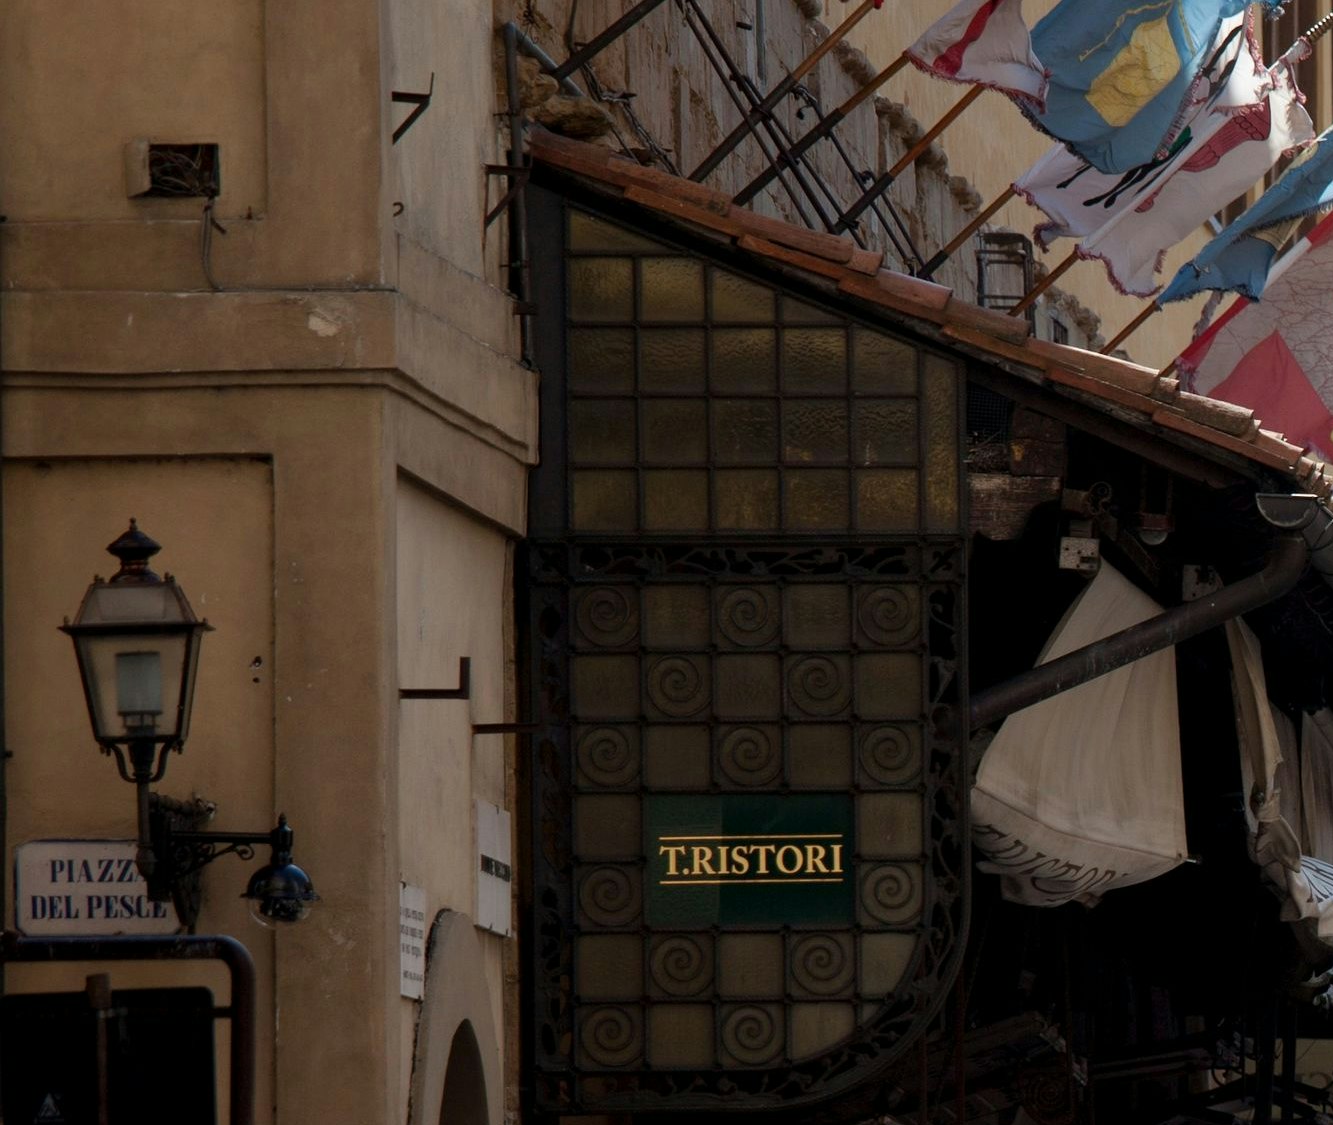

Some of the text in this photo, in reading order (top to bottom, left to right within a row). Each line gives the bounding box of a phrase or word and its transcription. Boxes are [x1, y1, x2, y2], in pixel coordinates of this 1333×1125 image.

[50, 859, 147, 883] PIAZZ
[659, 844, 844, 875] T.RISTORI
[31, 894, 167, 920] DEL PESCE
